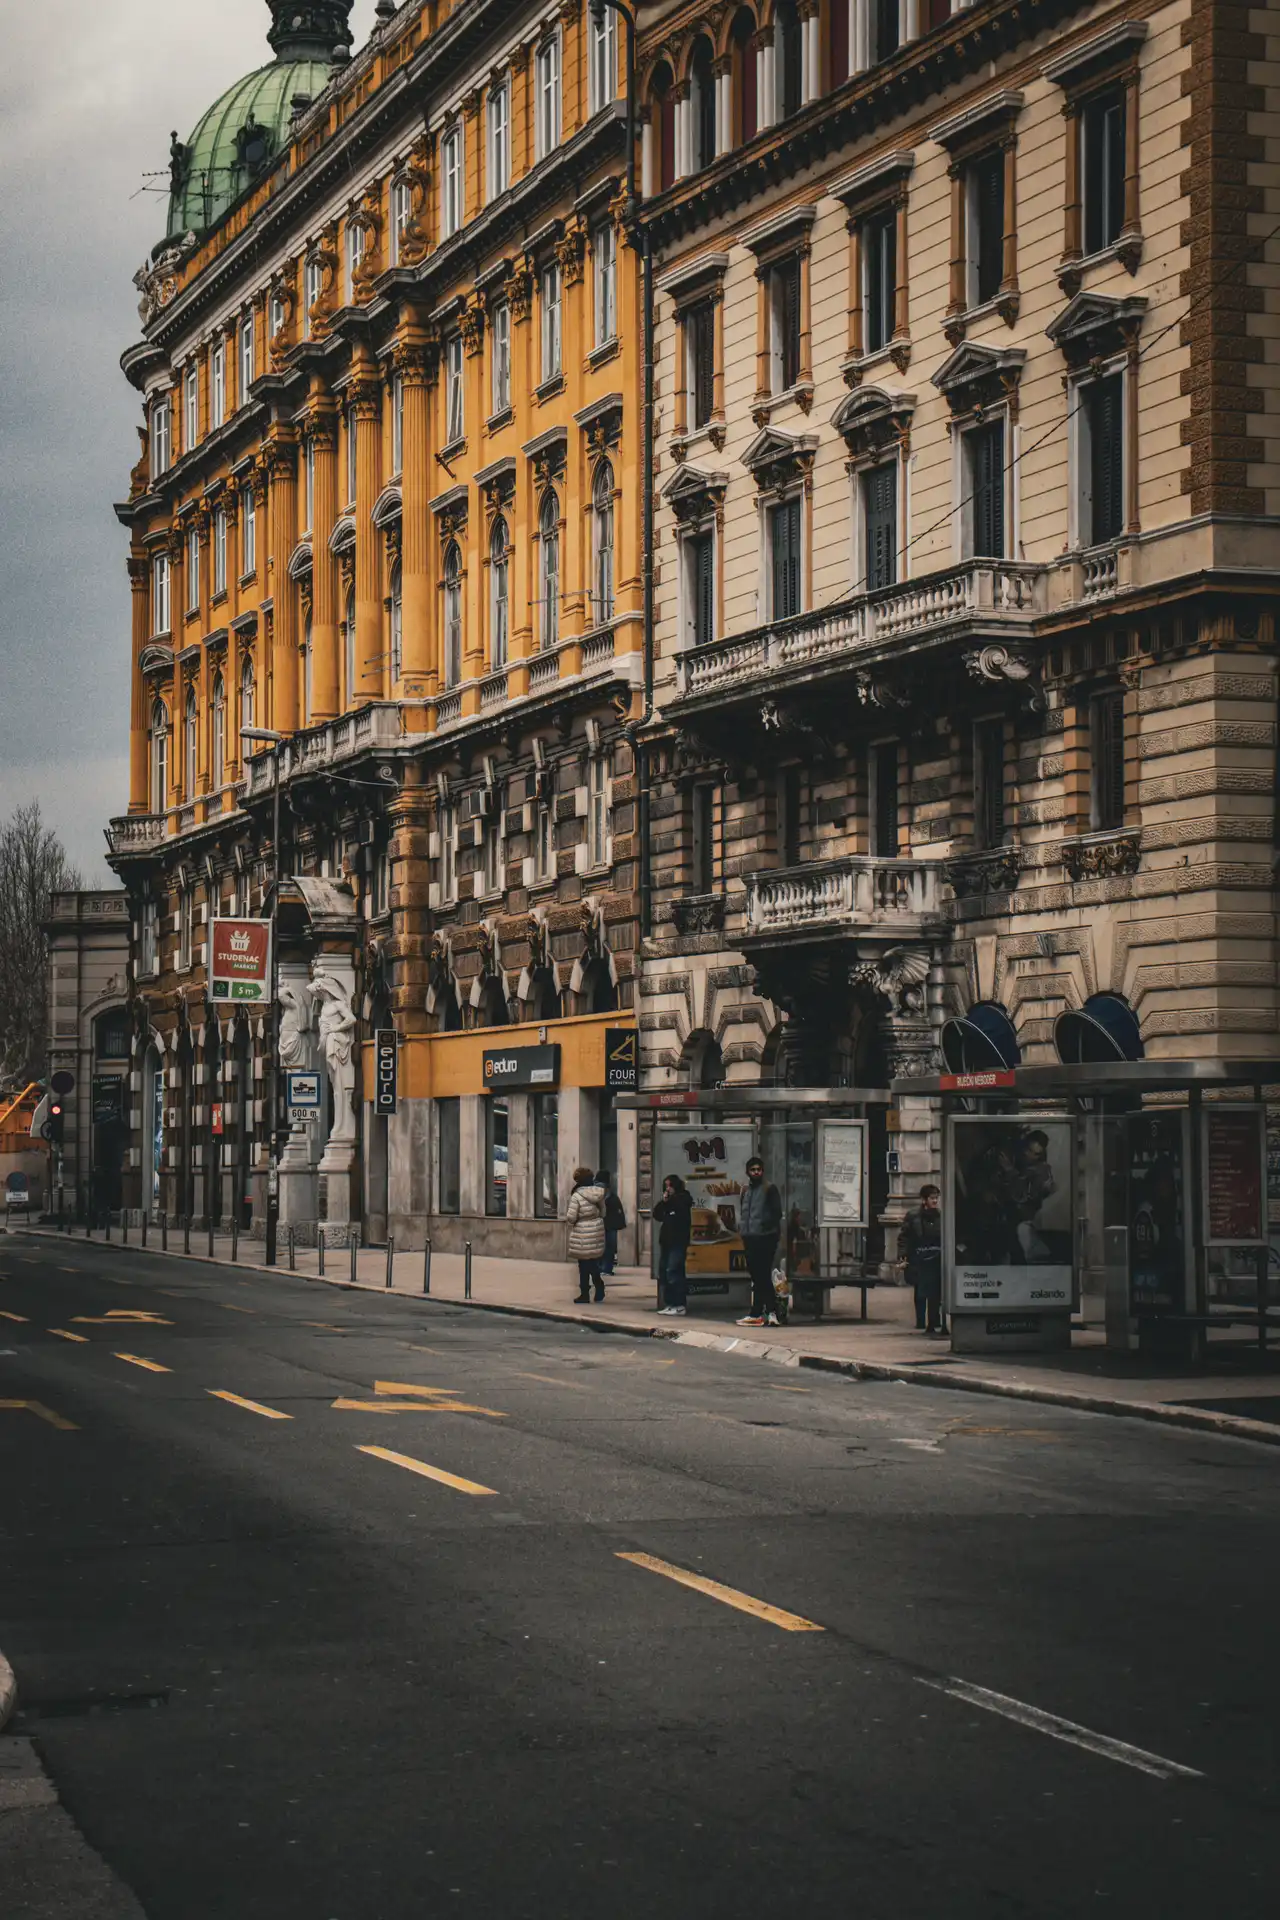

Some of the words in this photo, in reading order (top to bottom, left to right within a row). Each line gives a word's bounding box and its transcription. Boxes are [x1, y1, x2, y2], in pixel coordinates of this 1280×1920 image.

[218, 953, 260, 963] STUDENAC
[494, 1058, 518, 1074] eduro
[380, 1046, 393, 1105] eduro
[609, 1069, 636, 1080] FOUR
[292, 1109, 307, 1118] 600
[310, 1110, 317, 1118] m
[1030, 1289, 1066, 1299] zalando
